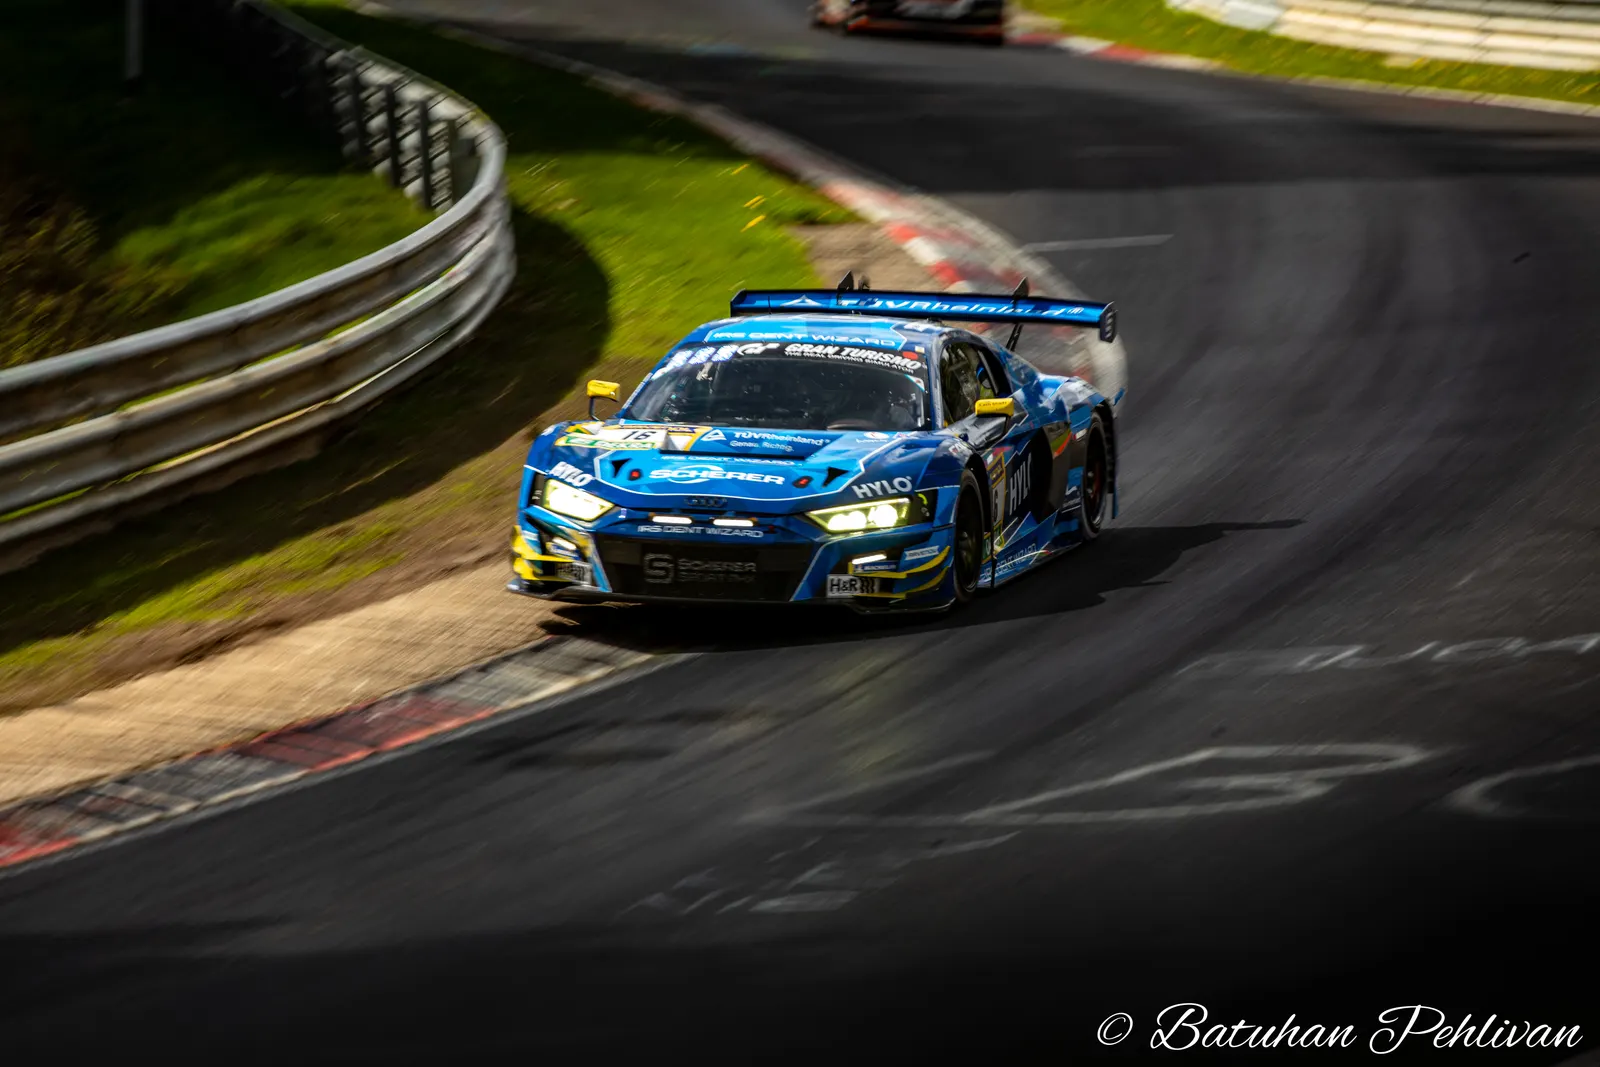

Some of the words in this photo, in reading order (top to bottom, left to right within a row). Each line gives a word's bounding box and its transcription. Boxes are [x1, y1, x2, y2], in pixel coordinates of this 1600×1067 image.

[748, 332, 809, 341] DENT
[811, 334, 896, 347] WIZARD
[784, 343, 840, 355] GRAN
[840, 347, 921, 370] TURISMO
[827, 354, 864, 363] DRIVING
[864, 358, 914, 374] SIMULATOR
[548, 461, 594, 487] HYLO
[649, 469, 785, 485] SCHERER
[852, 476, 913, 499] HYLO
[663, 525, 705, 535] DENT
[705, 527, 764, 538] WIZARD
[677, 557, 757, 572] SCHERER
[829, 577, 858, 594] H&R
